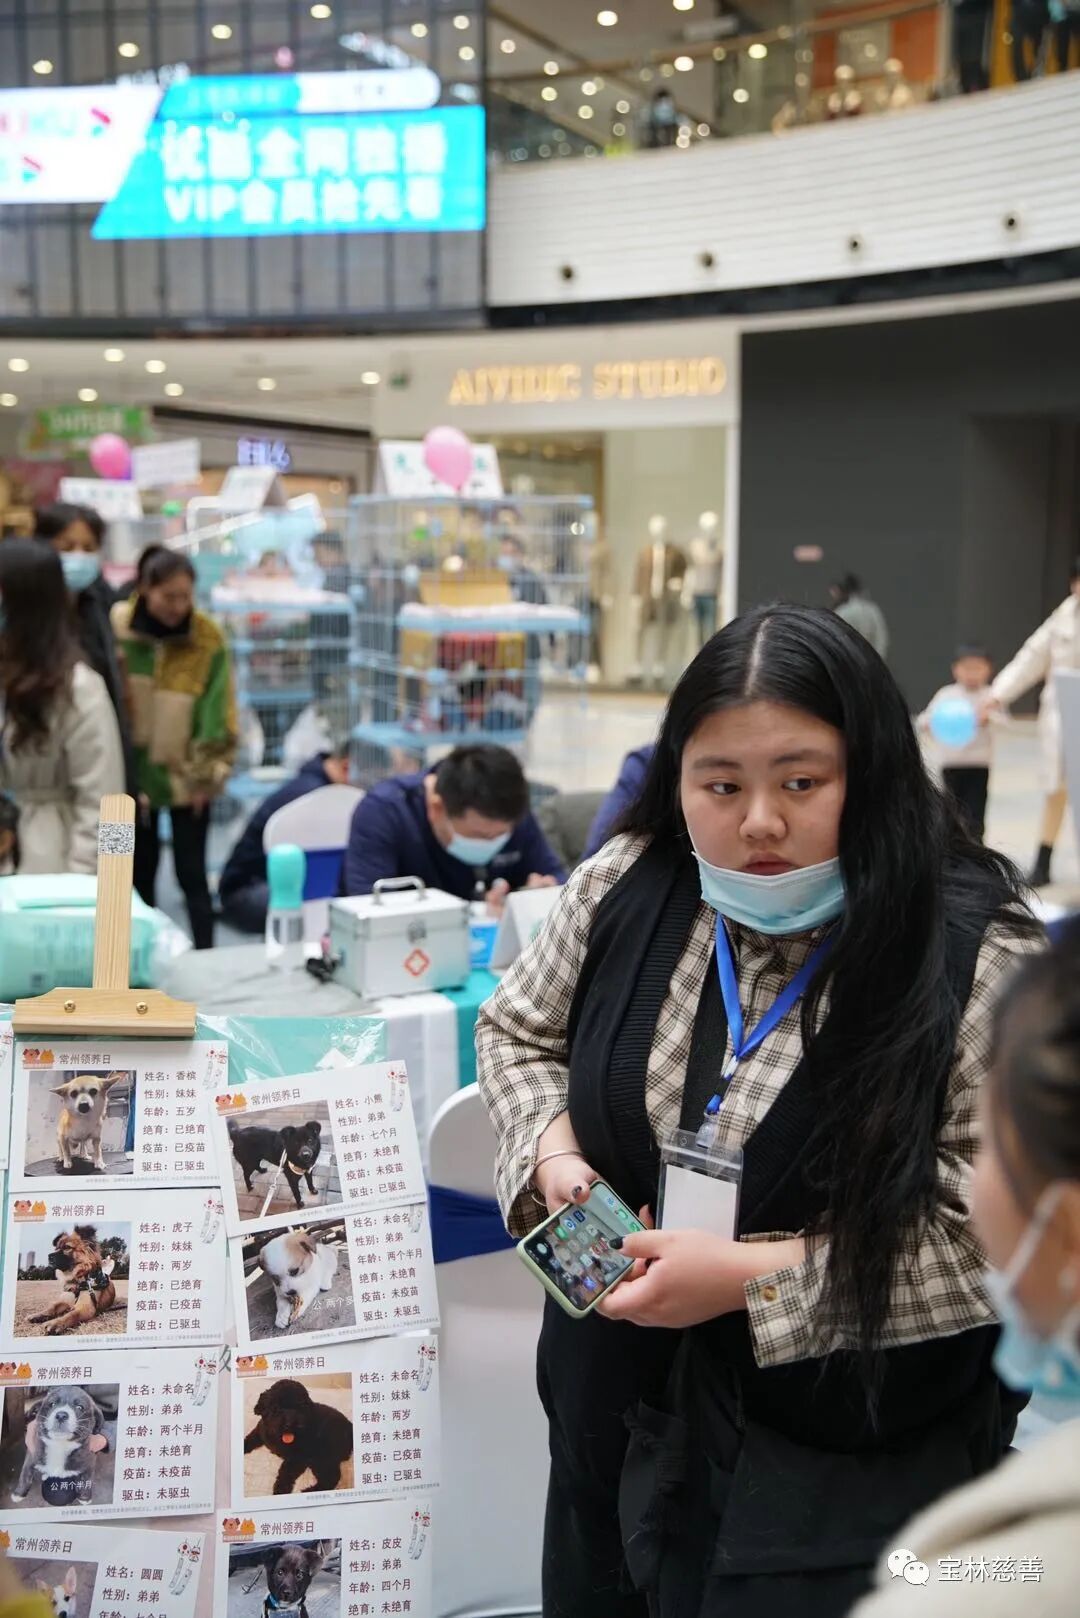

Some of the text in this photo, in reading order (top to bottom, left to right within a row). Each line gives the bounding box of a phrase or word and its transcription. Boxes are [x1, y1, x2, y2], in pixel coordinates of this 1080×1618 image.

[593, 356, 726, 399] STUDIO
[59, 1053, 111, 1065] 常州领养日
[144, 1088, 197, 1100] 性别：妹妹
[251, 1088, 301, 1105] 常州领养日
[335, 1093, 382, 1109] 姓名：小熊
[143, 1106, 196, 1117] 年龄：五岁
[337, 1112, 386, 1127] 性别：弟弟
[142, 1123, 207, 1135] 绝育：已绝育
[340, 1128, 397, 1144] 年龄：七个月
[142, 1142, 206, 1153] 疫苗：已疫苗
[343, 1144, 400, 1162] 绝育：未绝育
[141, 1160, 205, 1172] 驱虫：已驱虫
[346, 1163, 403, 1181] 疫苗：未疫苗
[349, 1181, 406, 1199] 驱虫：已驱虫
[51, 1205, 105, 1217] 常州领养日
[139, 1222, 194, 1233] 姓名：虎子
[353, 1212, 410, 1229] 姓名：未命名
[355, 1232, 403, 1246] 性别：弟弟
[139, 1241, 193, 1253] 性别：妹妹
[357, 1249, 423, 1264] 年龄：两个半月
[138, 1260, 192, 1272] 年龄：两岁
[359, 1267, 416, 1284] 绝育：未绝育
[137, 1279, 202, 1292] 绝育：已绝育
[361, 1286, 419, 1303] 疫苗：未疫苗
[136, 1298, 202, 1311] 疫苗：已疫苗
[363, 1304, 420, 1321] 驱虫：未驱虫
[135, 1318, 201, 1331] 驱虫：已驱虫
[273, 1357, 325, 1370] 常州领养日
[37, 1366, 93, 1380] 常州领养日
[360, 1371, 420, 1384] 姓名：未命名
[128, 1383, 195, 1396] 姓名：未命名
[360, 1390, 411, 1404] 性别：妹妹
[127, 1404, 183, 1416] 性别：弟弟
[361, 1410, 411, 1424] 年龄：两岁
[126, 1424, 203, 1437] 年龄：两个半月
[361, 1428, 421, 1444] 绝育：未绝育
[124, 1445, 192, 1459] 绝育：未绝育
[361, 1448, 421, 1465] 疫苗：已疫苗
[123, 1466, 191, 1480] 疫苗：未疫苗
[362, 1469, 422, 1485] 驱虫：已驱虫
[122, 1486, 190, 1501] 驱虫：未驱虫
[260, 1522, 314, 1536] 常州领养日
[15, 1537, 72, 1553] 常州领养日
[349, 1537, 402, 1551] 姓名：皮皮
[105, 1565, 163, 1581] 姓名：圆圆
[349, 1559, 402, 1573] 性别：弟弟
[349, 1579, 411, 1594] 年龄：四个月
[102, 1588, 160, 1602] 性别：弟弟
[348, 1601, 412, 1616] 绝育：未绝育
